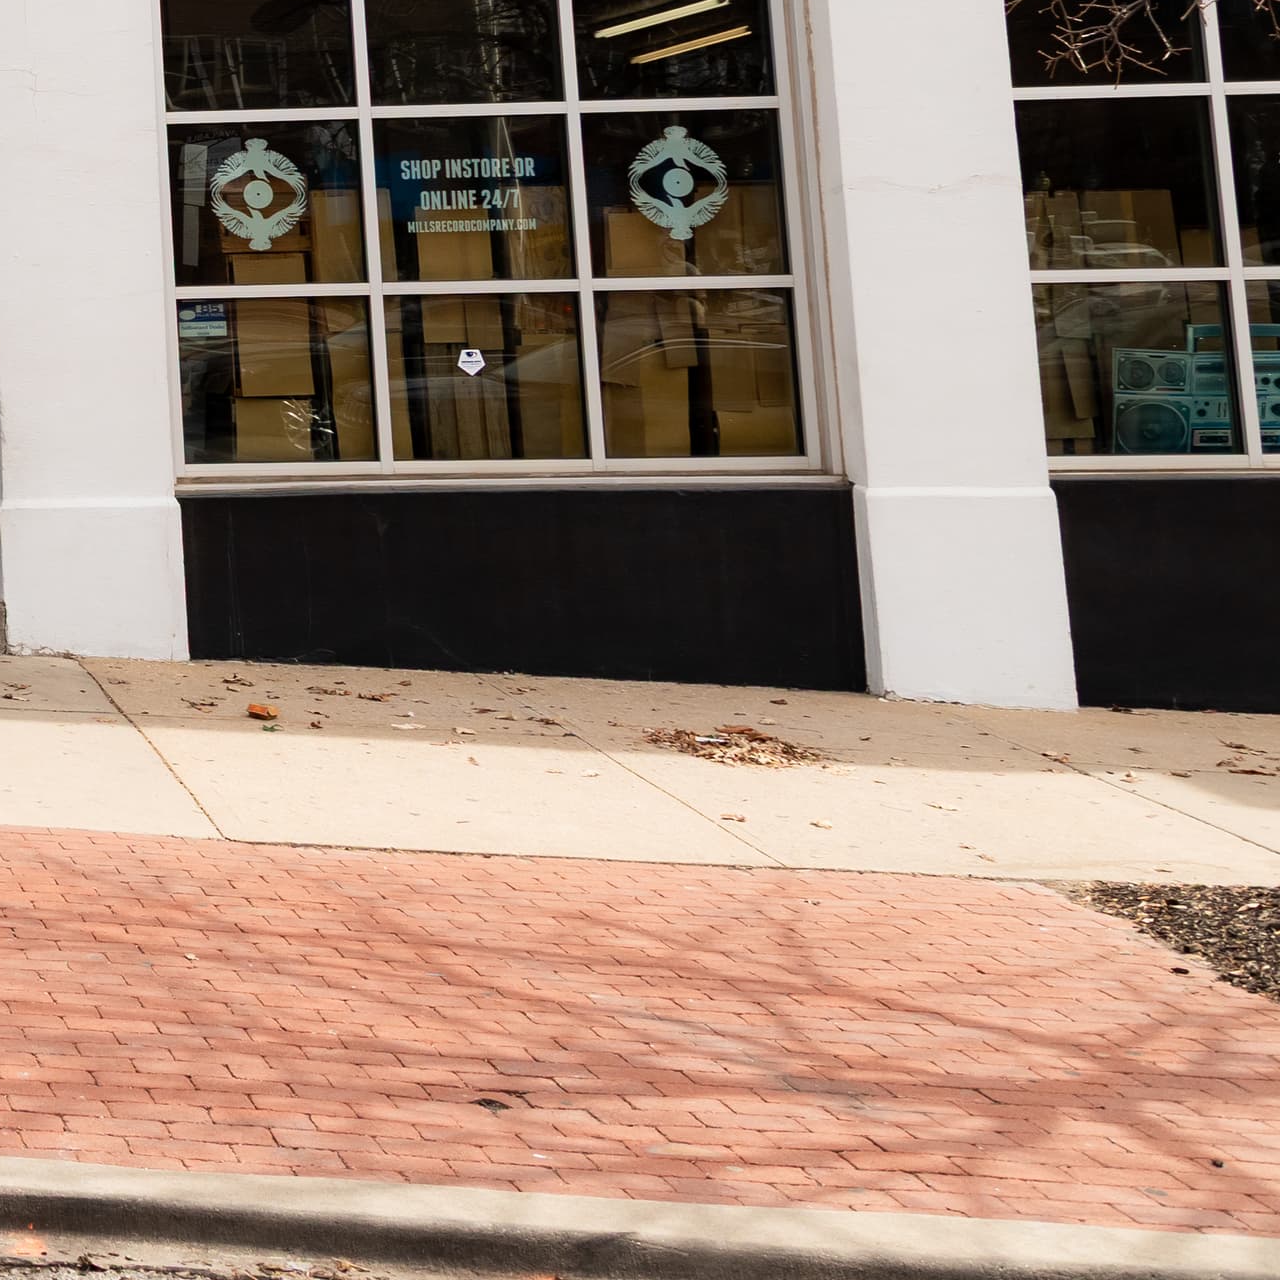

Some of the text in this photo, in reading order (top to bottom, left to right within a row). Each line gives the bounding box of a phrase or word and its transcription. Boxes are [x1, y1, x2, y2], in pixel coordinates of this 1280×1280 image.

[400, 157, 536, 180] SHOP INSTORE OR
[420, 189, 520, 210] ONLINE 24/7
[407, 218, 537, 233] MILLSRECORDCOMPANY.COM
